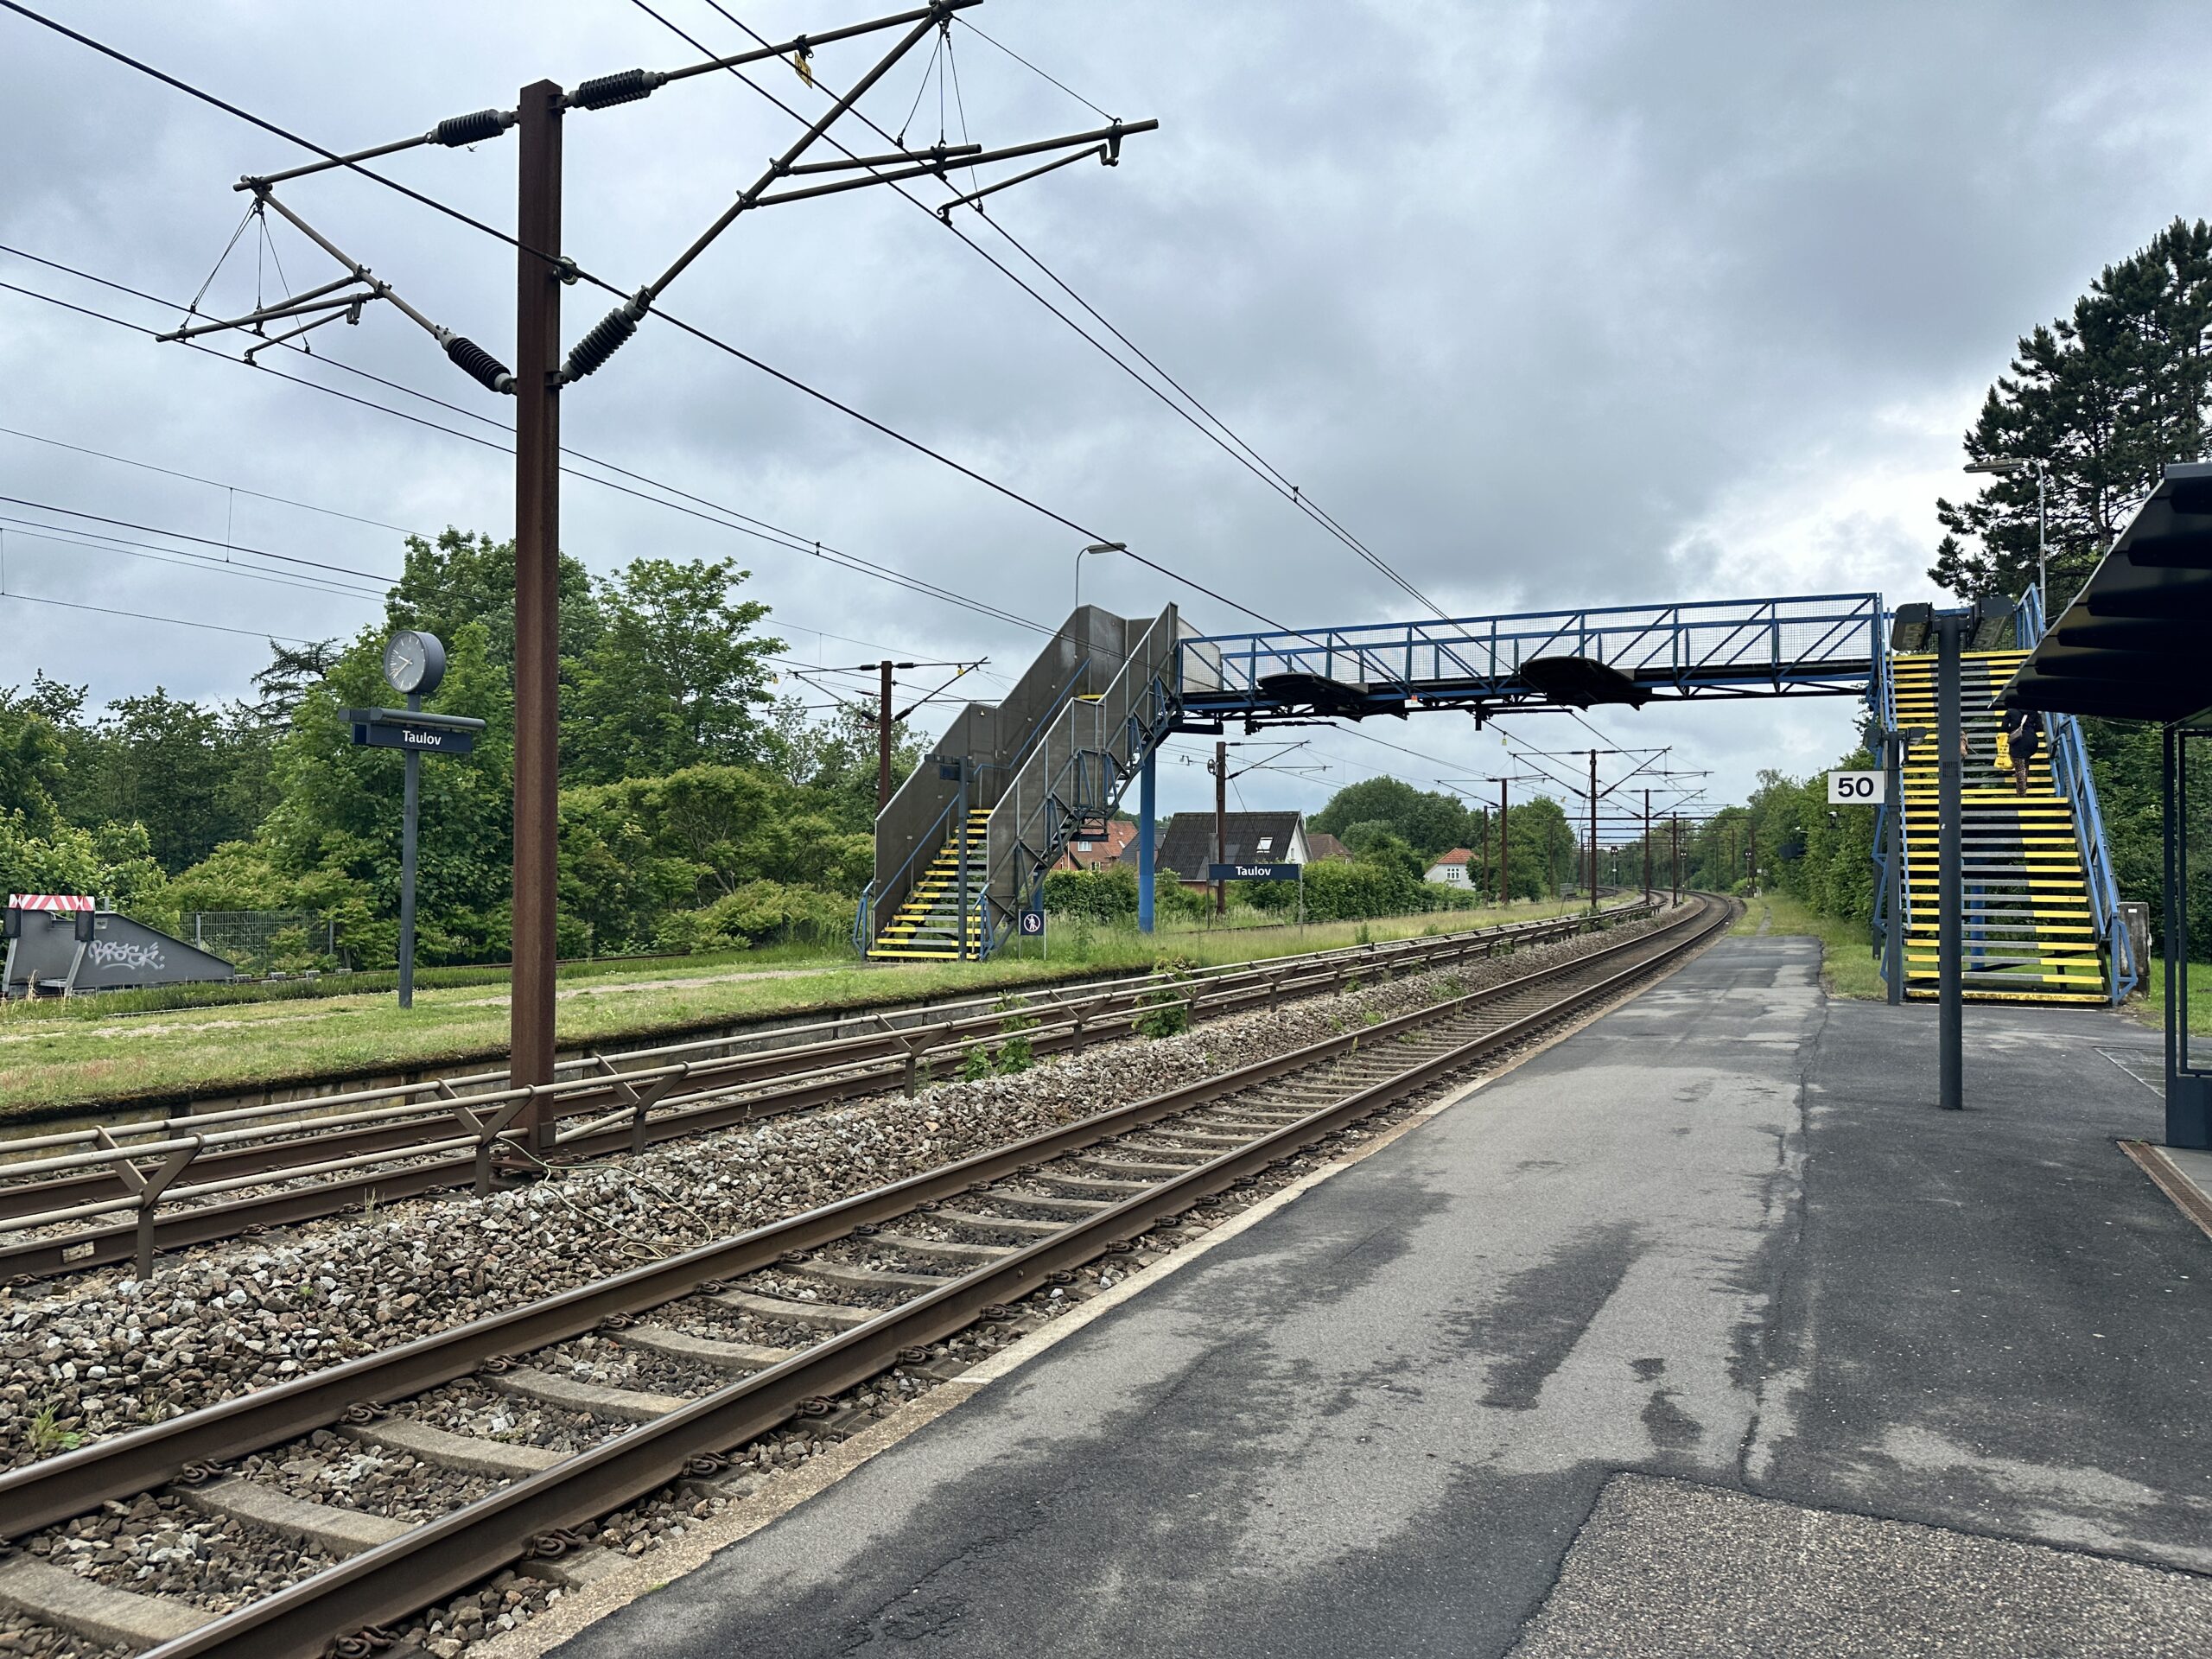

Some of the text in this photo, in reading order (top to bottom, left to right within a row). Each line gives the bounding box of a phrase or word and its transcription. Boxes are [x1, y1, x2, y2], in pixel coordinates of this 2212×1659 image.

[403, 730, 442, 746] Taulov
[1838, 777, 1874, 798] 50
[1235, 866, 1272, 876] Taulov
